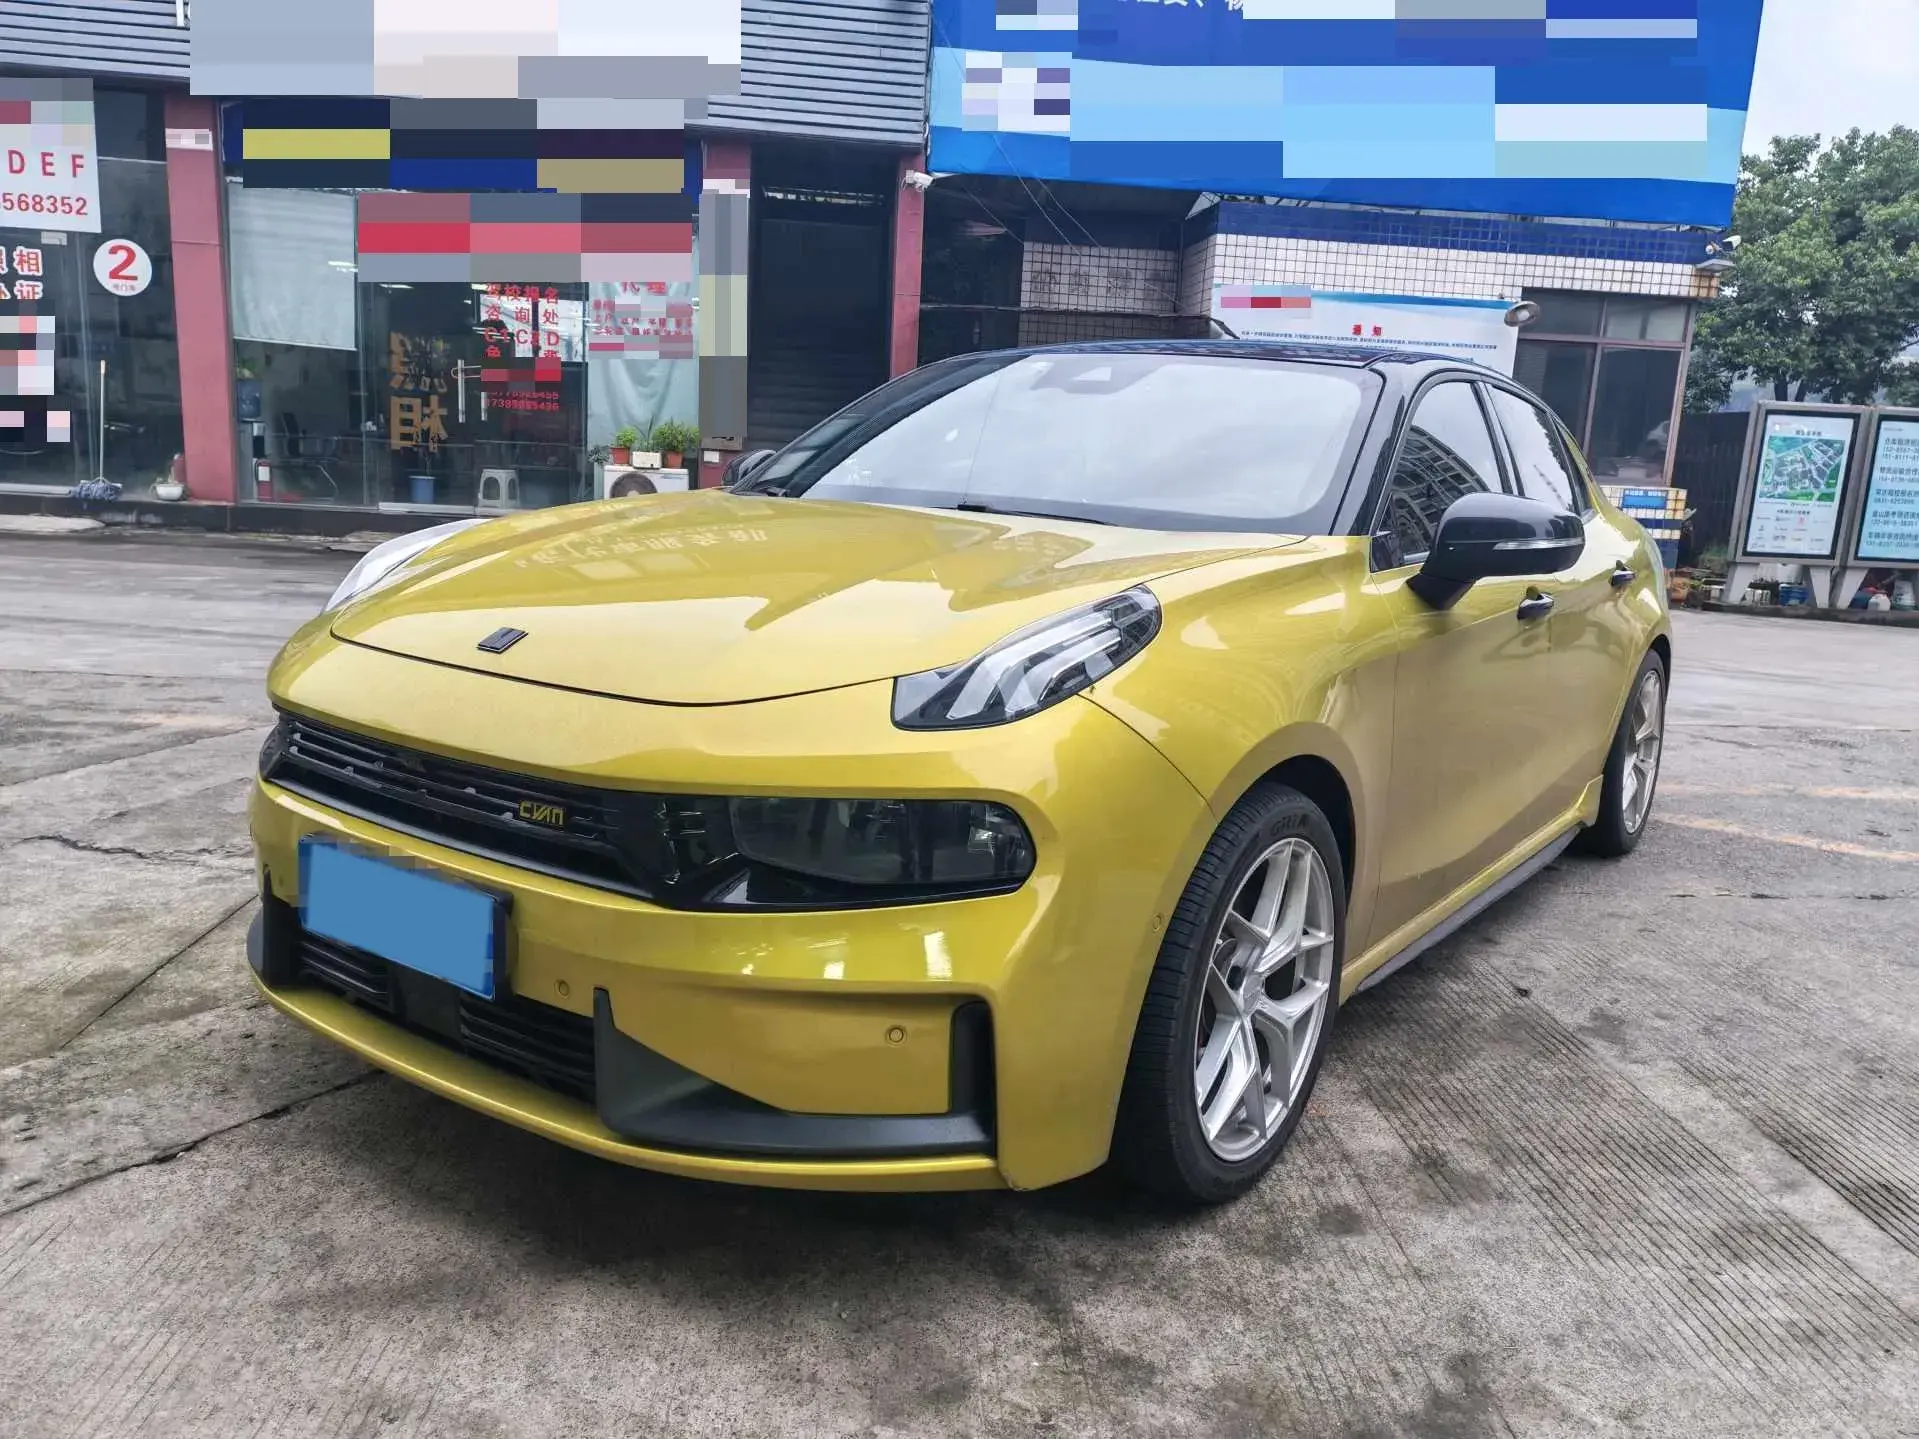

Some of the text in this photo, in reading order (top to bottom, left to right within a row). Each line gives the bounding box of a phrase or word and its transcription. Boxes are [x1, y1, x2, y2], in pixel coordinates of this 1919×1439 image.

[1, 192, 88, 215] 568352
[108, 244, 138, 281] 2
[546, 331, 560, 346] D
